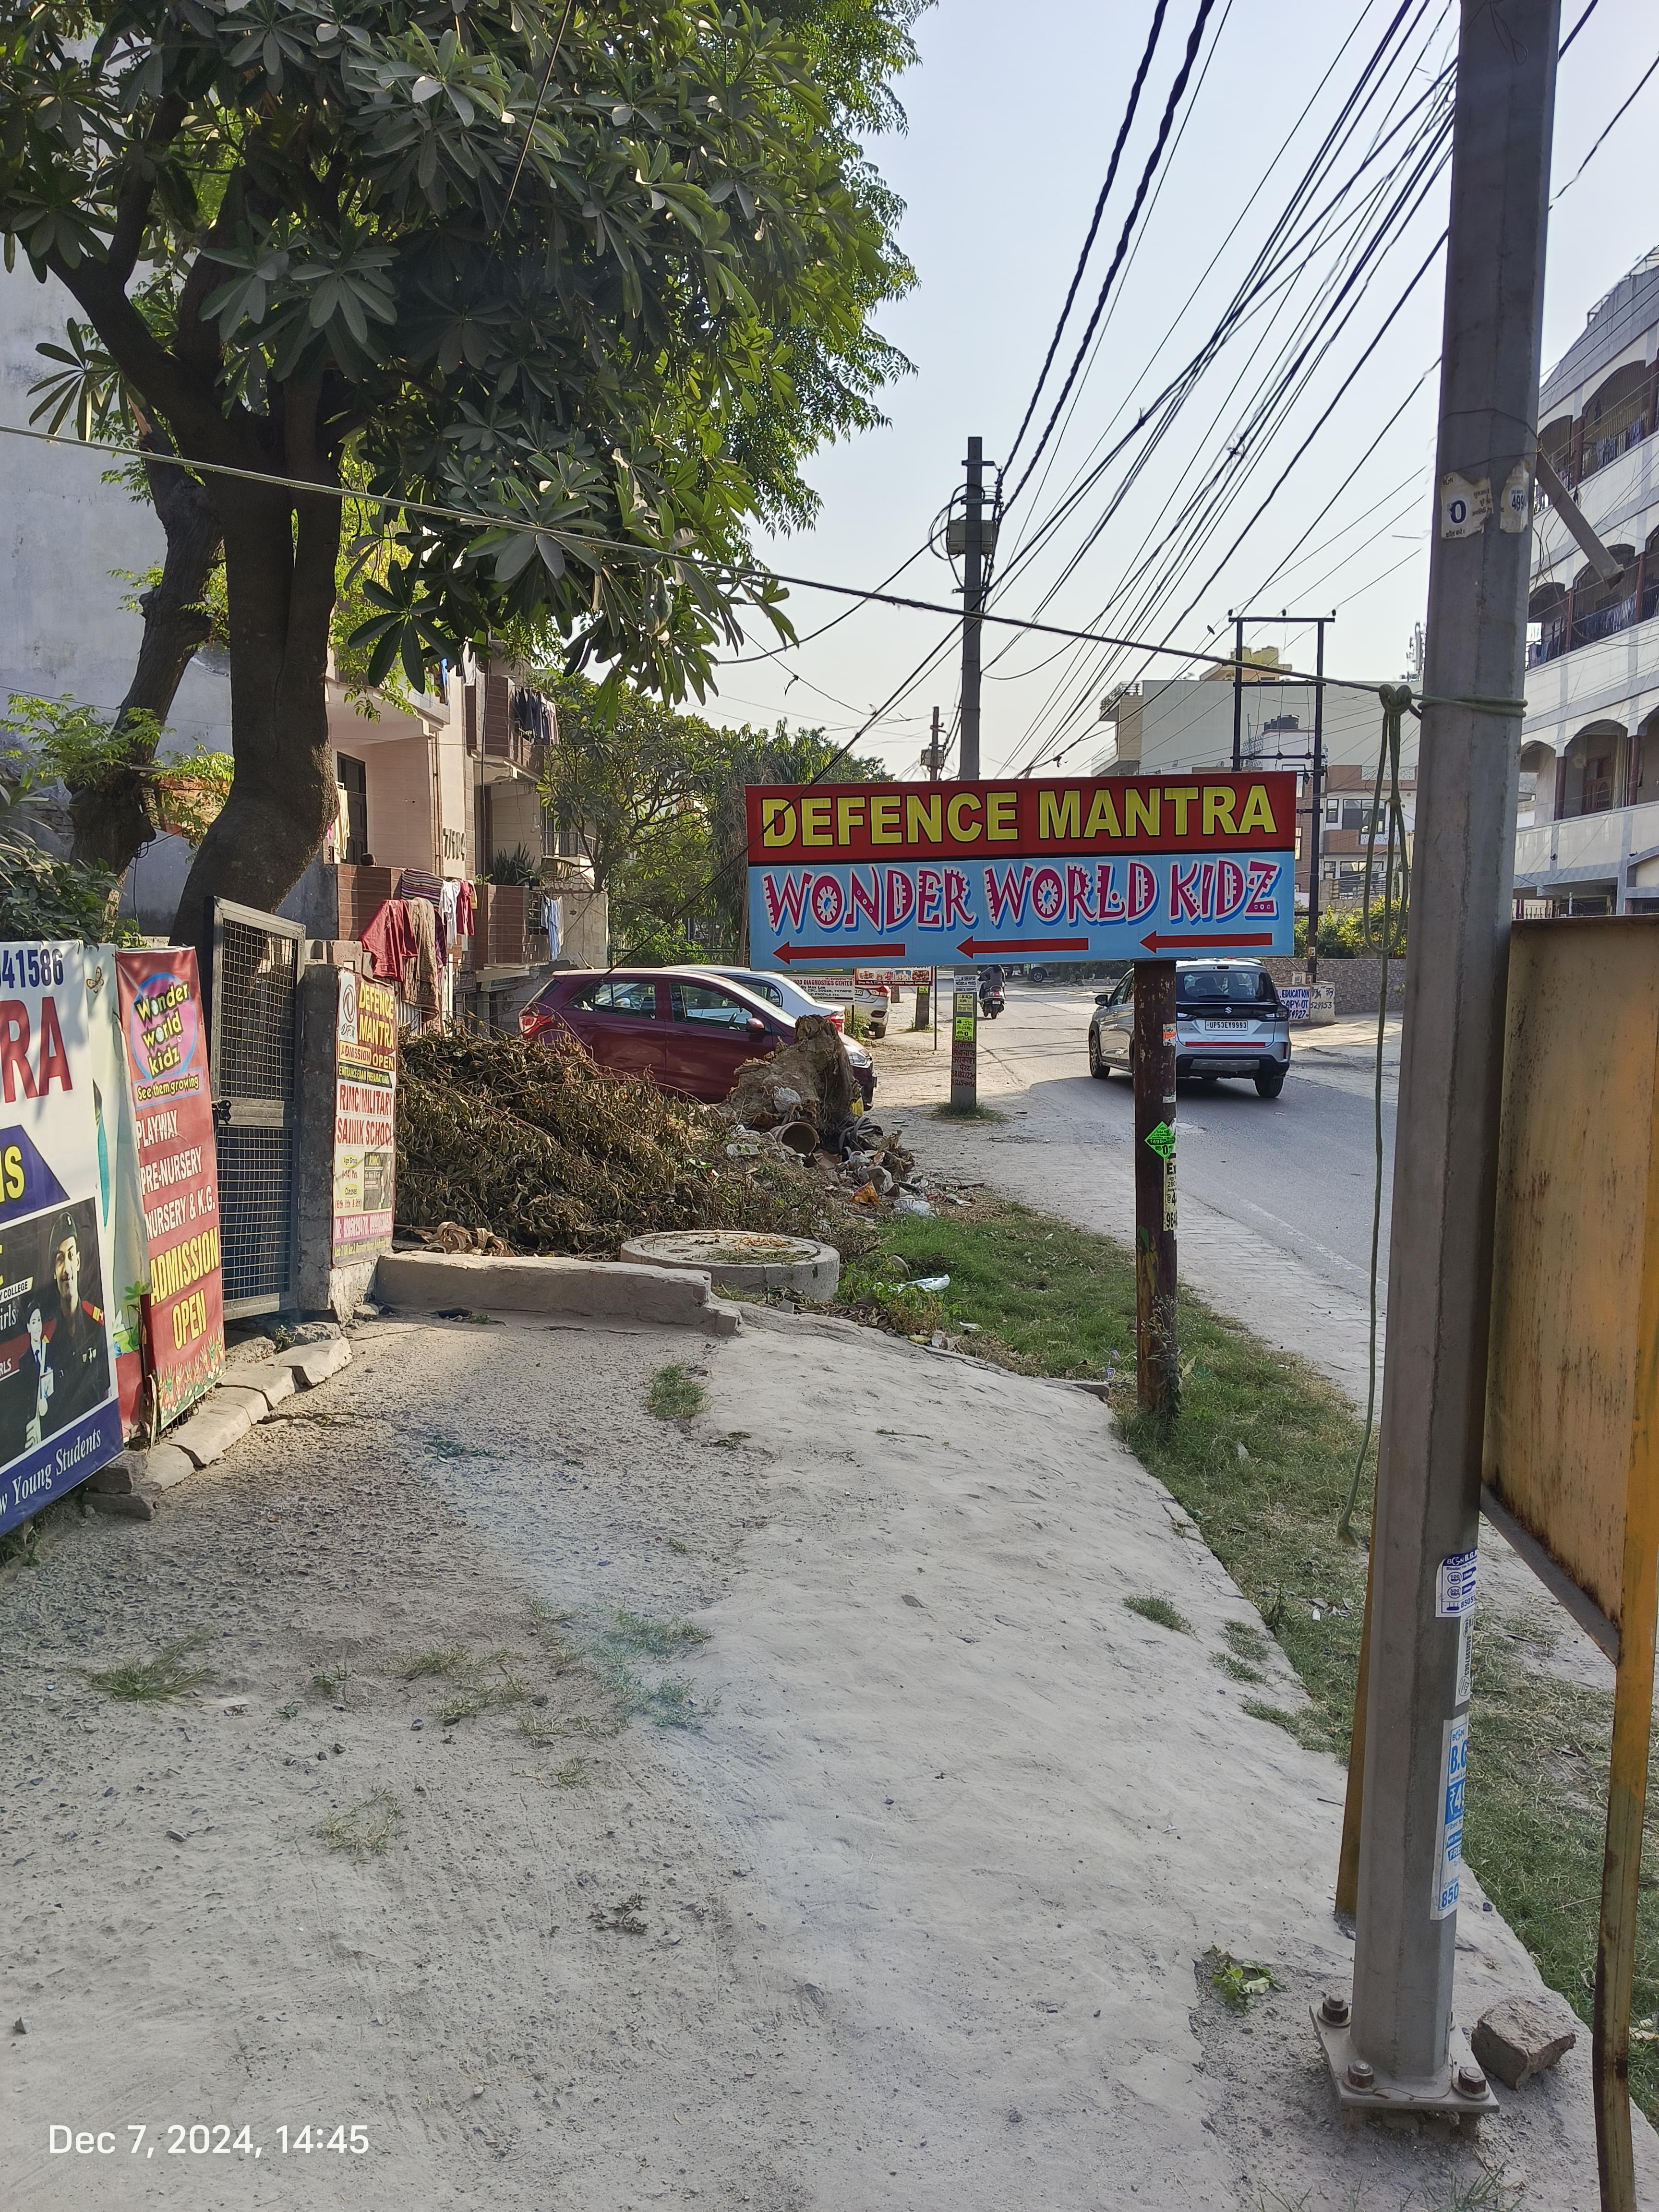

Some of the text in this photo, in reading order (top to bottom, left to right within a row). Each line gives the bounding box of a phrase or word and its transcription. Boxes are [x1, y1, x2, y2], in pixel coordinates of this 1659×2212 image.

[762, 784, 1278, 847] DEFENCE MANTRA
[762, 856, 1283, 936] WONDER WORLD KIDZ
[0, 948, 64, 989] 41586
[135, 982, 189, 1026] Wonder
[359, 982, 394, 1020] DEFENCE
[1301, 1000, 1309, 1009] OT
[0, 996, 73, 1104] RA
[141, 1009, 183, 1051] world
[359, 1014, 394, 1050] MANTRA
[147, 1044, 181, 1078] kidz
[338, 1065, 357, 1079] ENTRANCE
[357, 1070, 367, 1081] EXAM
[341, 1044, 394, 1070] ADMISSION OPEN
[137, 1073, 200, 1101] See them growing
[136, 1109, 178, 1150] PLAYWAY
[337, 1118, 393, 1146] SAINIK SCHOOL
[139, 1145, 203, 1196] PRE-NURSERY
[144, 1184, 216, 1242] NURSERY & K.G.
[150, 1226, 219, 1307] ADMISSION
[3, 1281, 28, 1299] COLLEGE
[0, 1303, 17, 1332] irls
[172, 1289, 207, 1351] OPEN
[12, 1467, 52, 1506] Young
[55, 1428, 102, 1477] Students
[1441, 1880, 1459, 1908] 850
